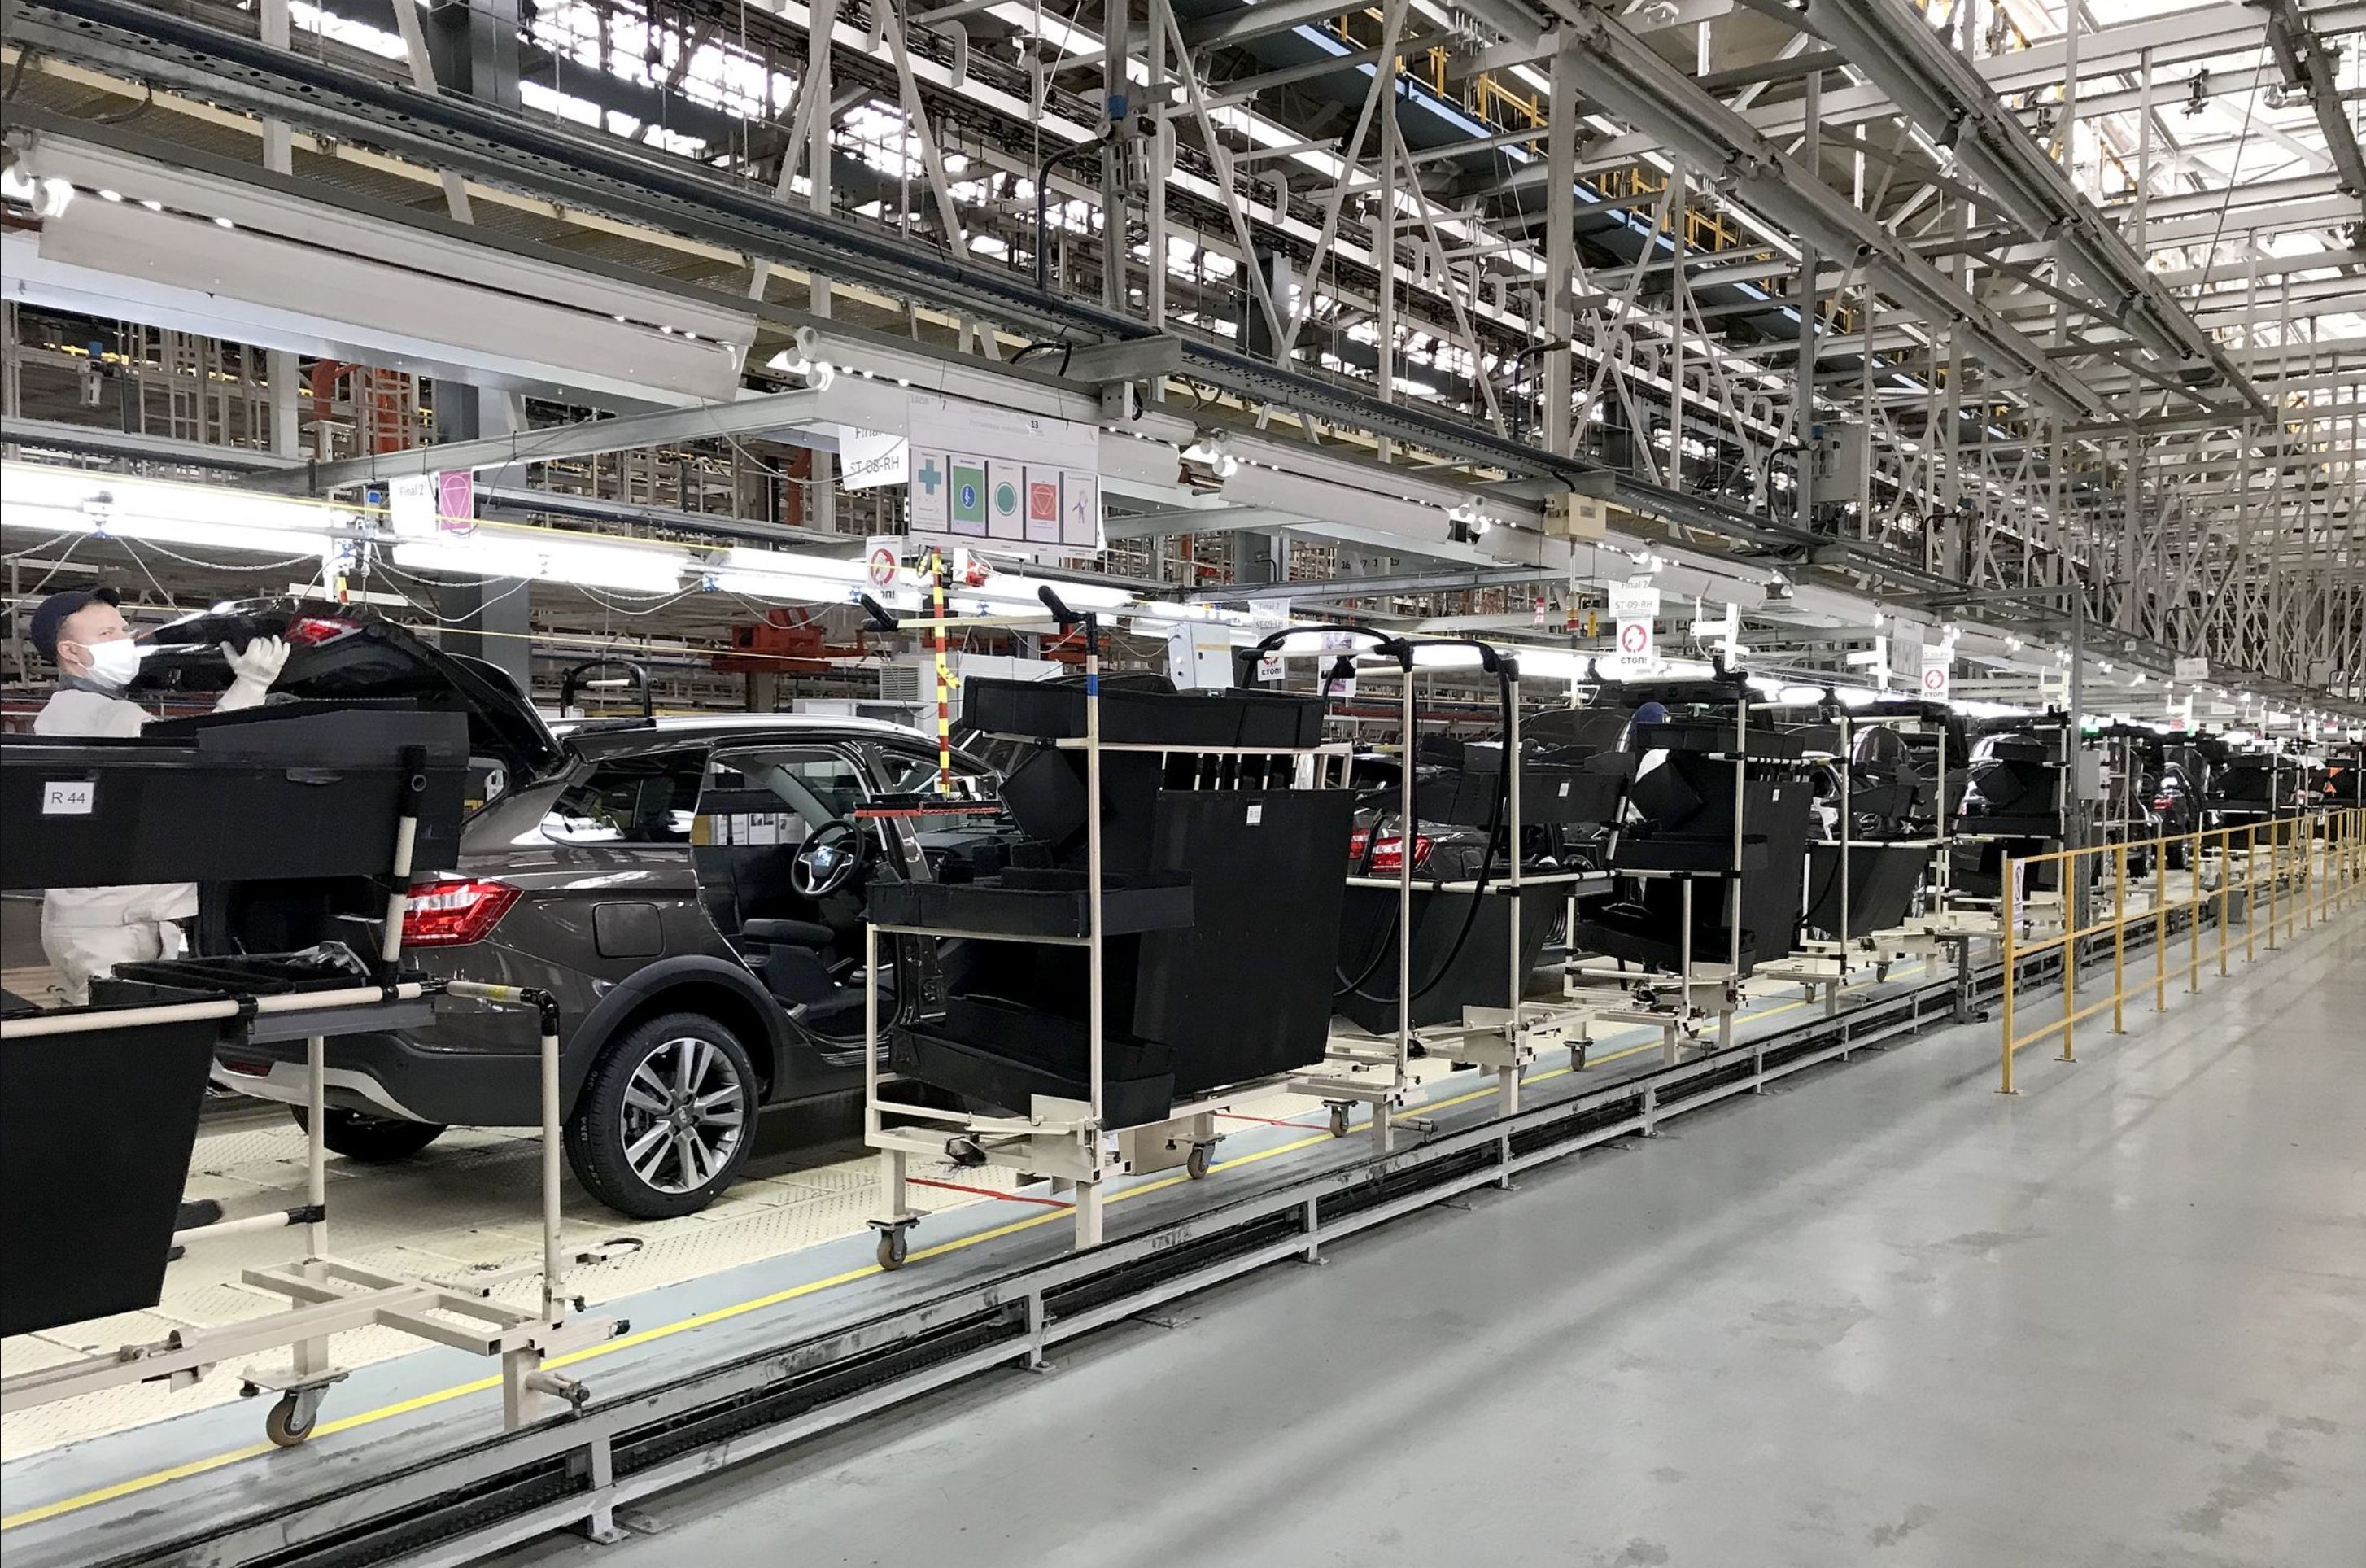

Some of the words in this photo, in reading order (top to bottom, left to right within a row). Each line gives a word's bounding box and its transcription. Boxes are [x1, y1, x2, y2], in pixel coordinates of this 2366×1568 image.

[1031, 420, 1038, 429] 13
[399, 483, 418, 496] Final
[419, 484, 424, 496] 2
[1342, 560, 1351, 569] 16
[1615, 600, 1652, 609] ST-09-RH
[51, 792, 63, 804] R
[67, 792, 85, 804] 44
